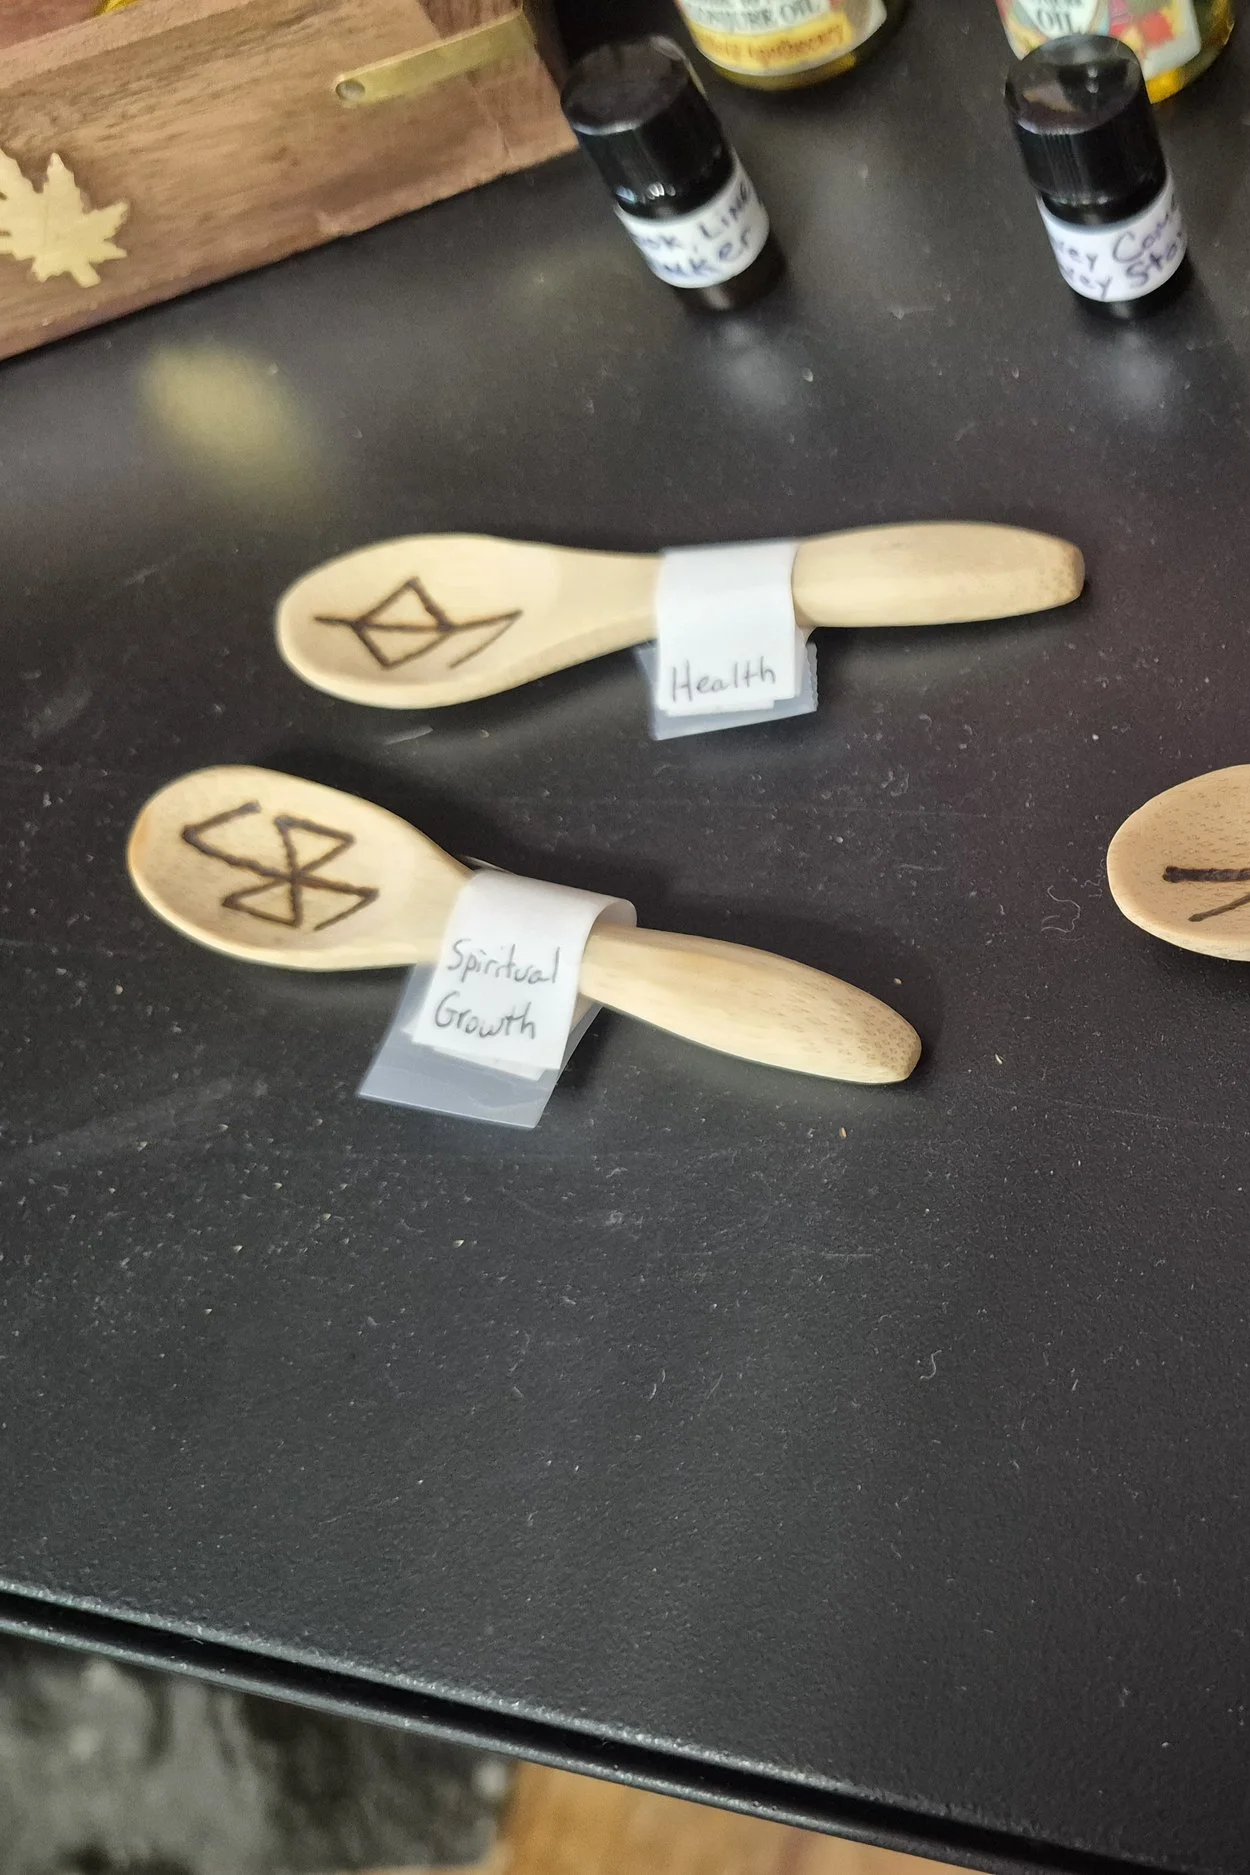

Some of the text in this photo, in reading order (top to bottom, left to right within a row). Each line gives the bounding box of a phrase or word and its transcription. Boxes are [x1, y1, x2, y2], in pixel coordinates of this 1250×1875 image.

[671, 655, 776, 703] Health
[447, 938, 561, 984] Spiritual
[434, 990, 537, 1040] Growth
